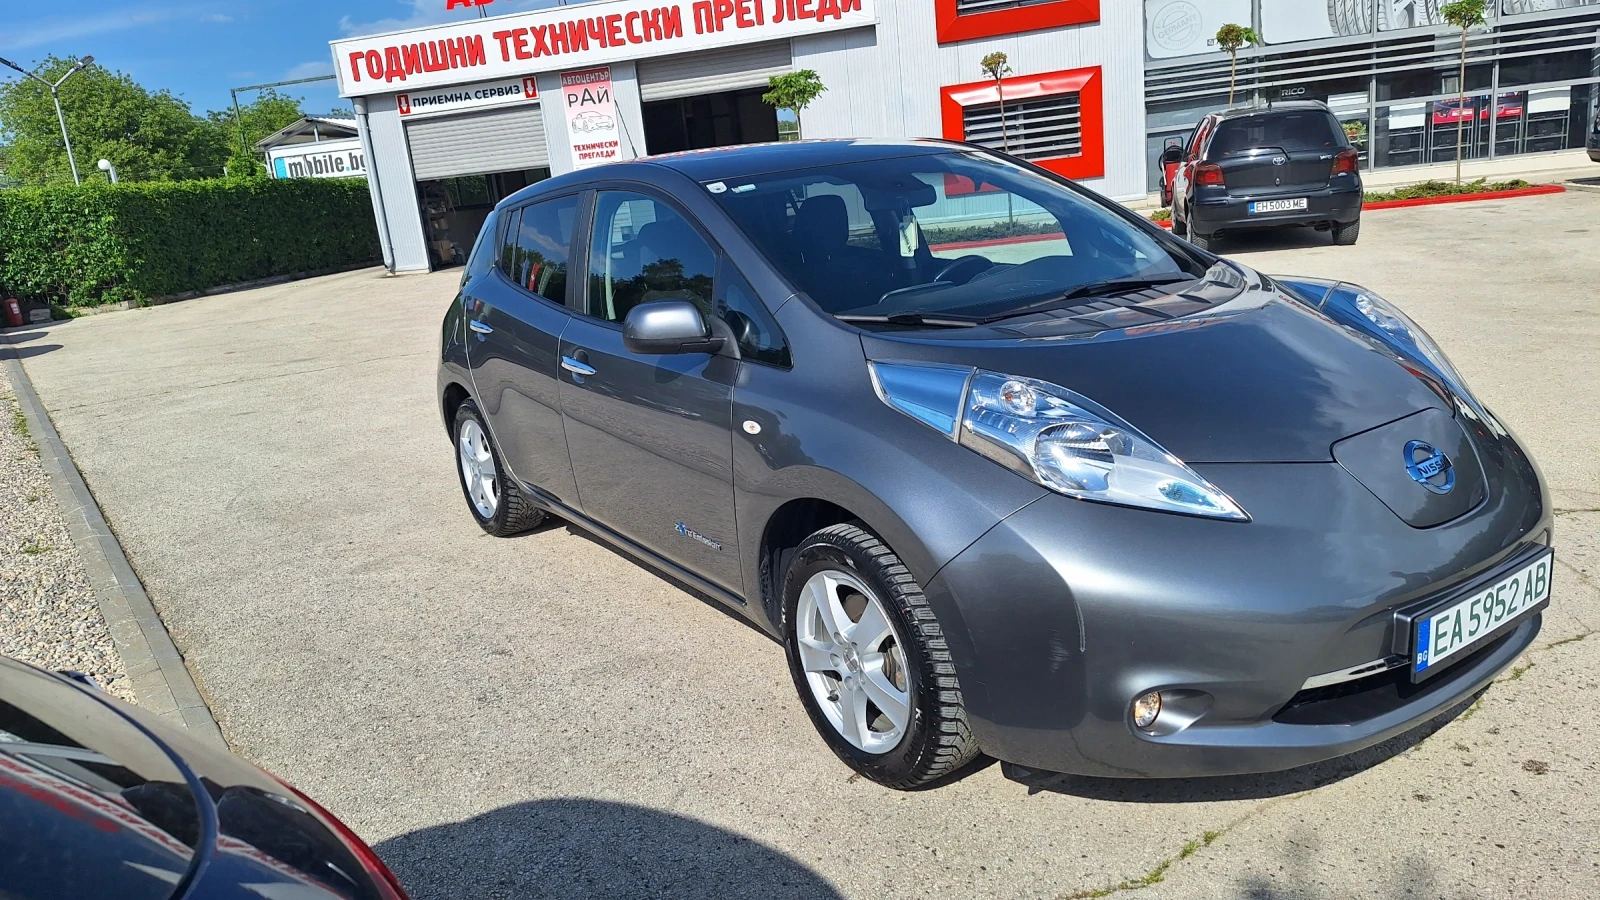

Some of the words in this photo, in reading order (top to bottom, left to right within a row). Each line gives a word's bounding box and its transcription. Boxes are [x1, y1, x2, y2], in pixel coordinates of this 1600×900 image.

[1158, 13, 1197, 39] GERMANY
[349, 34, 487, 83] ГОДИШНИ
[492, 3, 684, 62] ТЕХНИЧЕСКИ
[562, 71, 609, 85] АВТОЦЕНТЪР
[412, 92, 471, 108] ПРИЕМНА
[475, 84, 521, 100] СЕРВИЗ
[567, 85, 610, 107] РАЙ
[573, 140, 618, 152] ТЕХНИЧЕСКИ
[579, 149, 616, 160] ПРЕГЛЕДИ
[1256, 201, 1268, 211] EH
[1269, 200, 1292, 210] 5003
[1292, 199, 1305, 208] ME
[1434, 608, 1463, 657] EA
[1468, 578, 1520, 637] 5952
[1522, 561, 1547, 607] AB
[1416, 650, 1428, 665] BG
